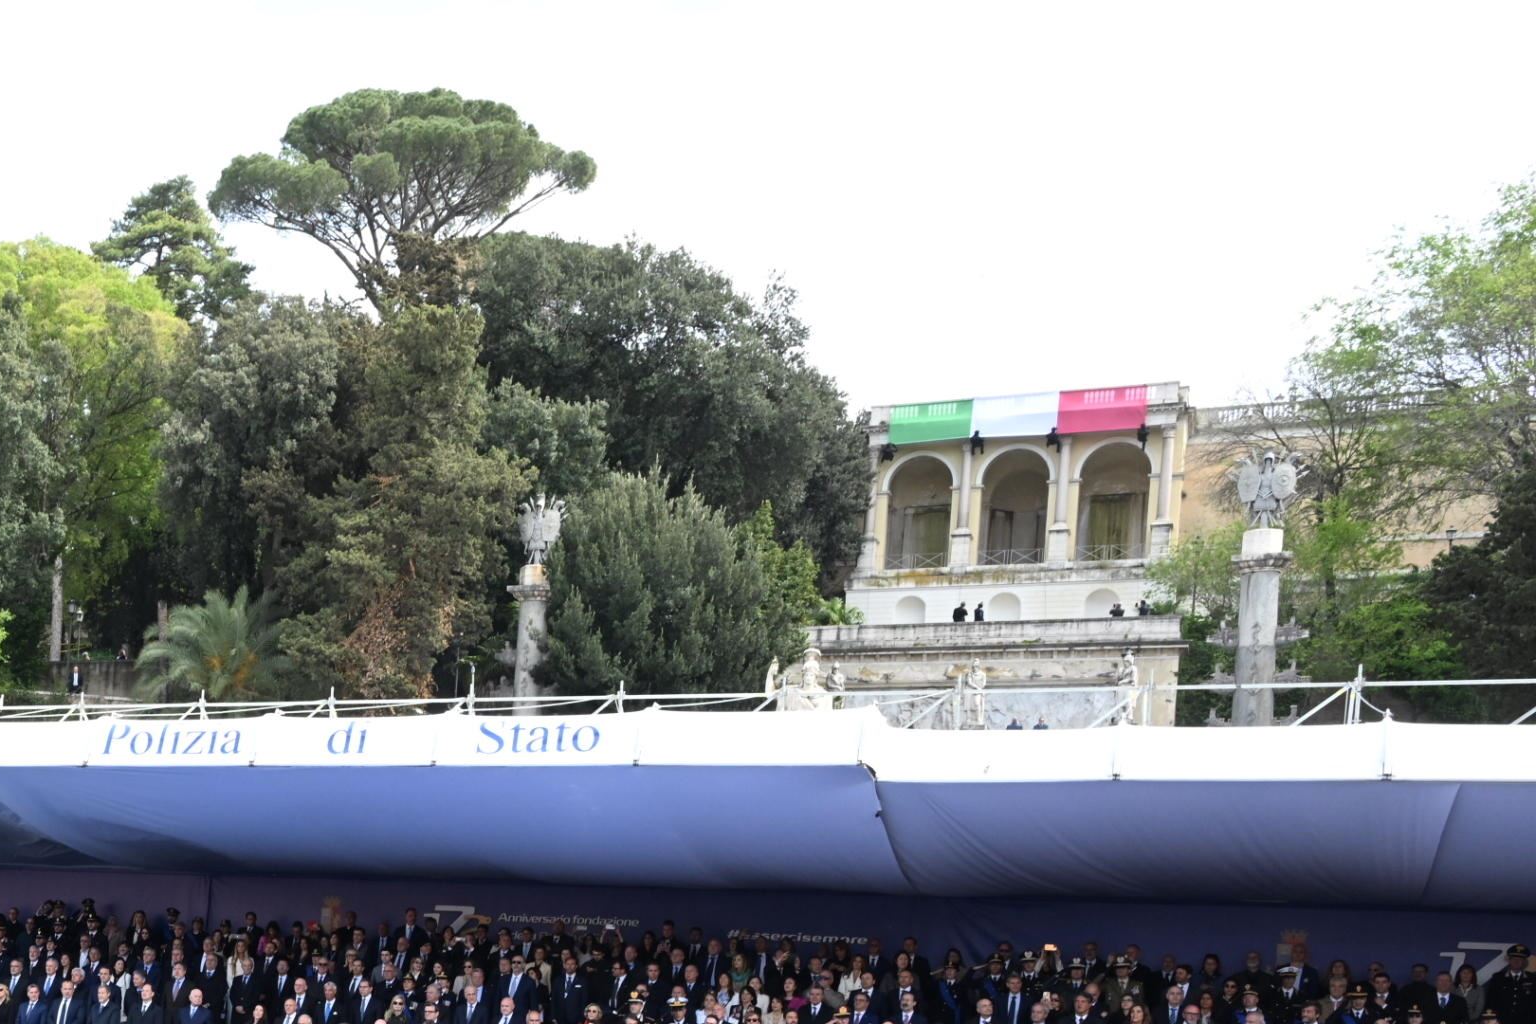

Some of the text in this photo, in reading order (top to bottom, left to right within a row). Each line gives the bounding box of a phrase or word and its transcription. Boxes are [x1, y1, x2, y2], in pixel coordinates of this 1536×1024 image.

[101, 719, 601, 756] Polizia di Stato
[571, 914, 639, 928] fondazione
